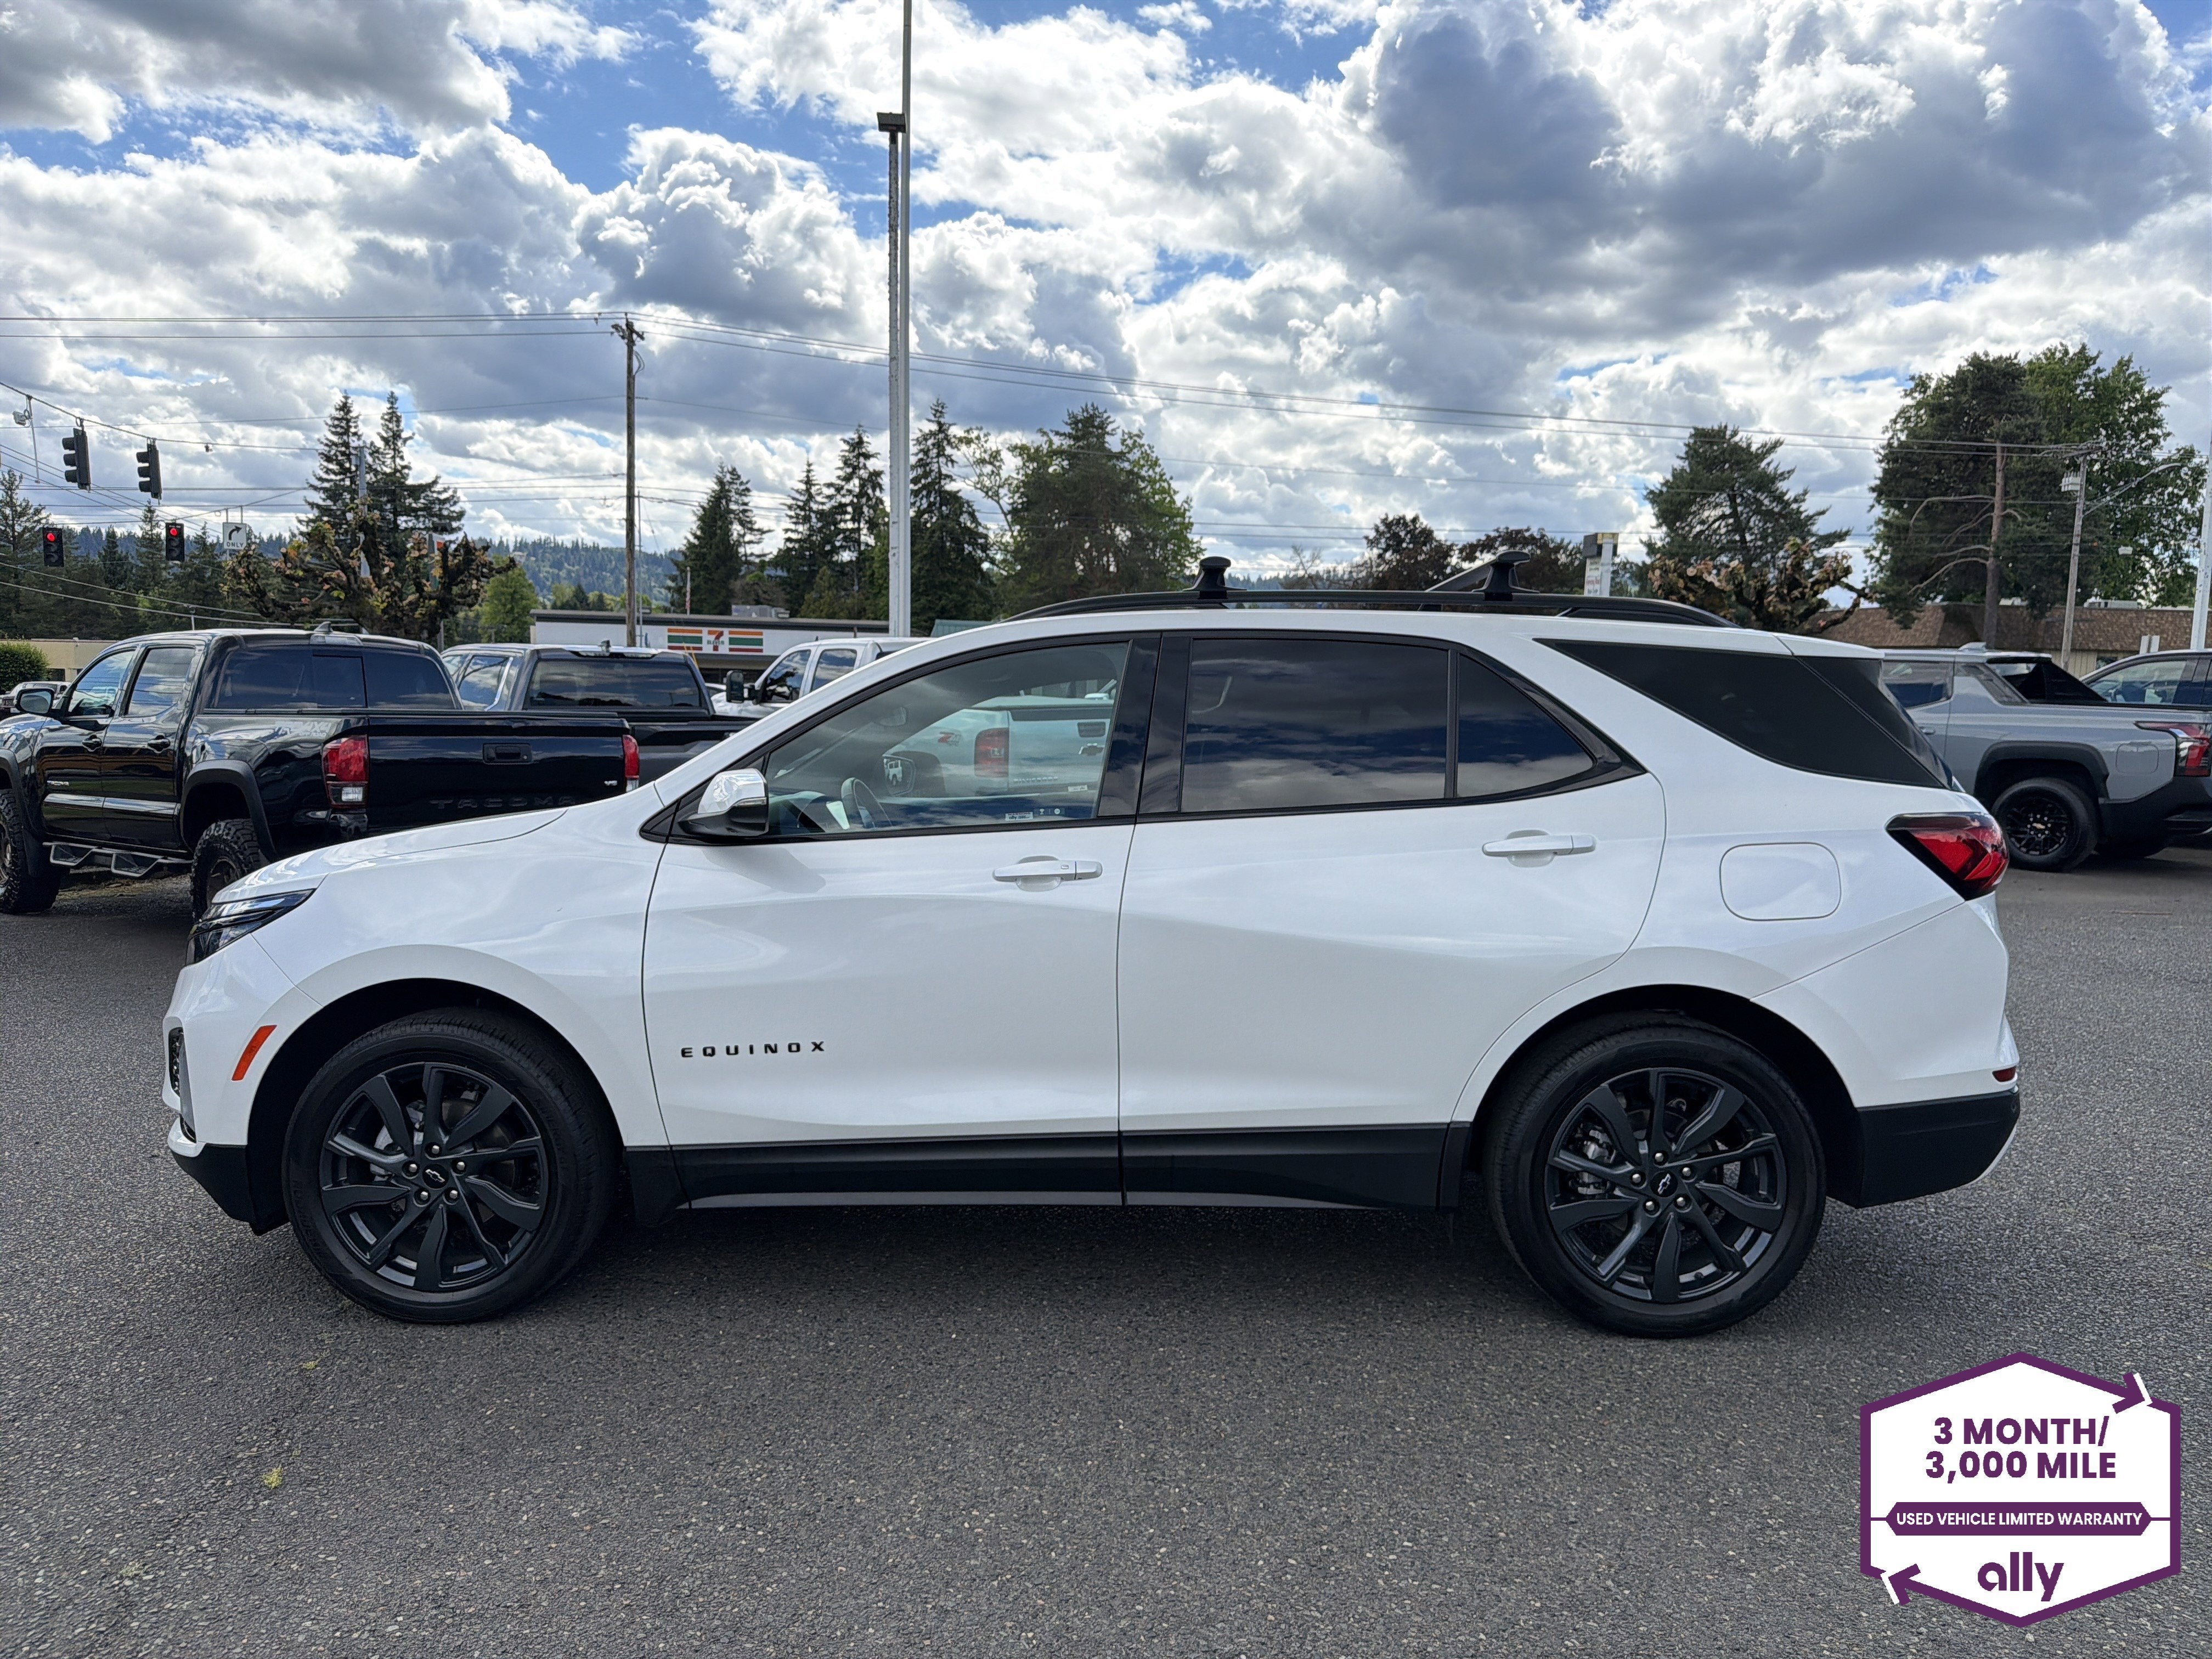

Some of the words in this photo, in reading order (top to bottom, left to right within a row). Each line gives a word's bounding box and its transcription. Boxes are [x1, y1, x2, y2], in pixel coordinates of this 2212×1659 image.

[708, 630, 724, 651] 7
[430, 795, 575, 809] TACOMA
[681, 1041, 825, 1058] EQUINOX
